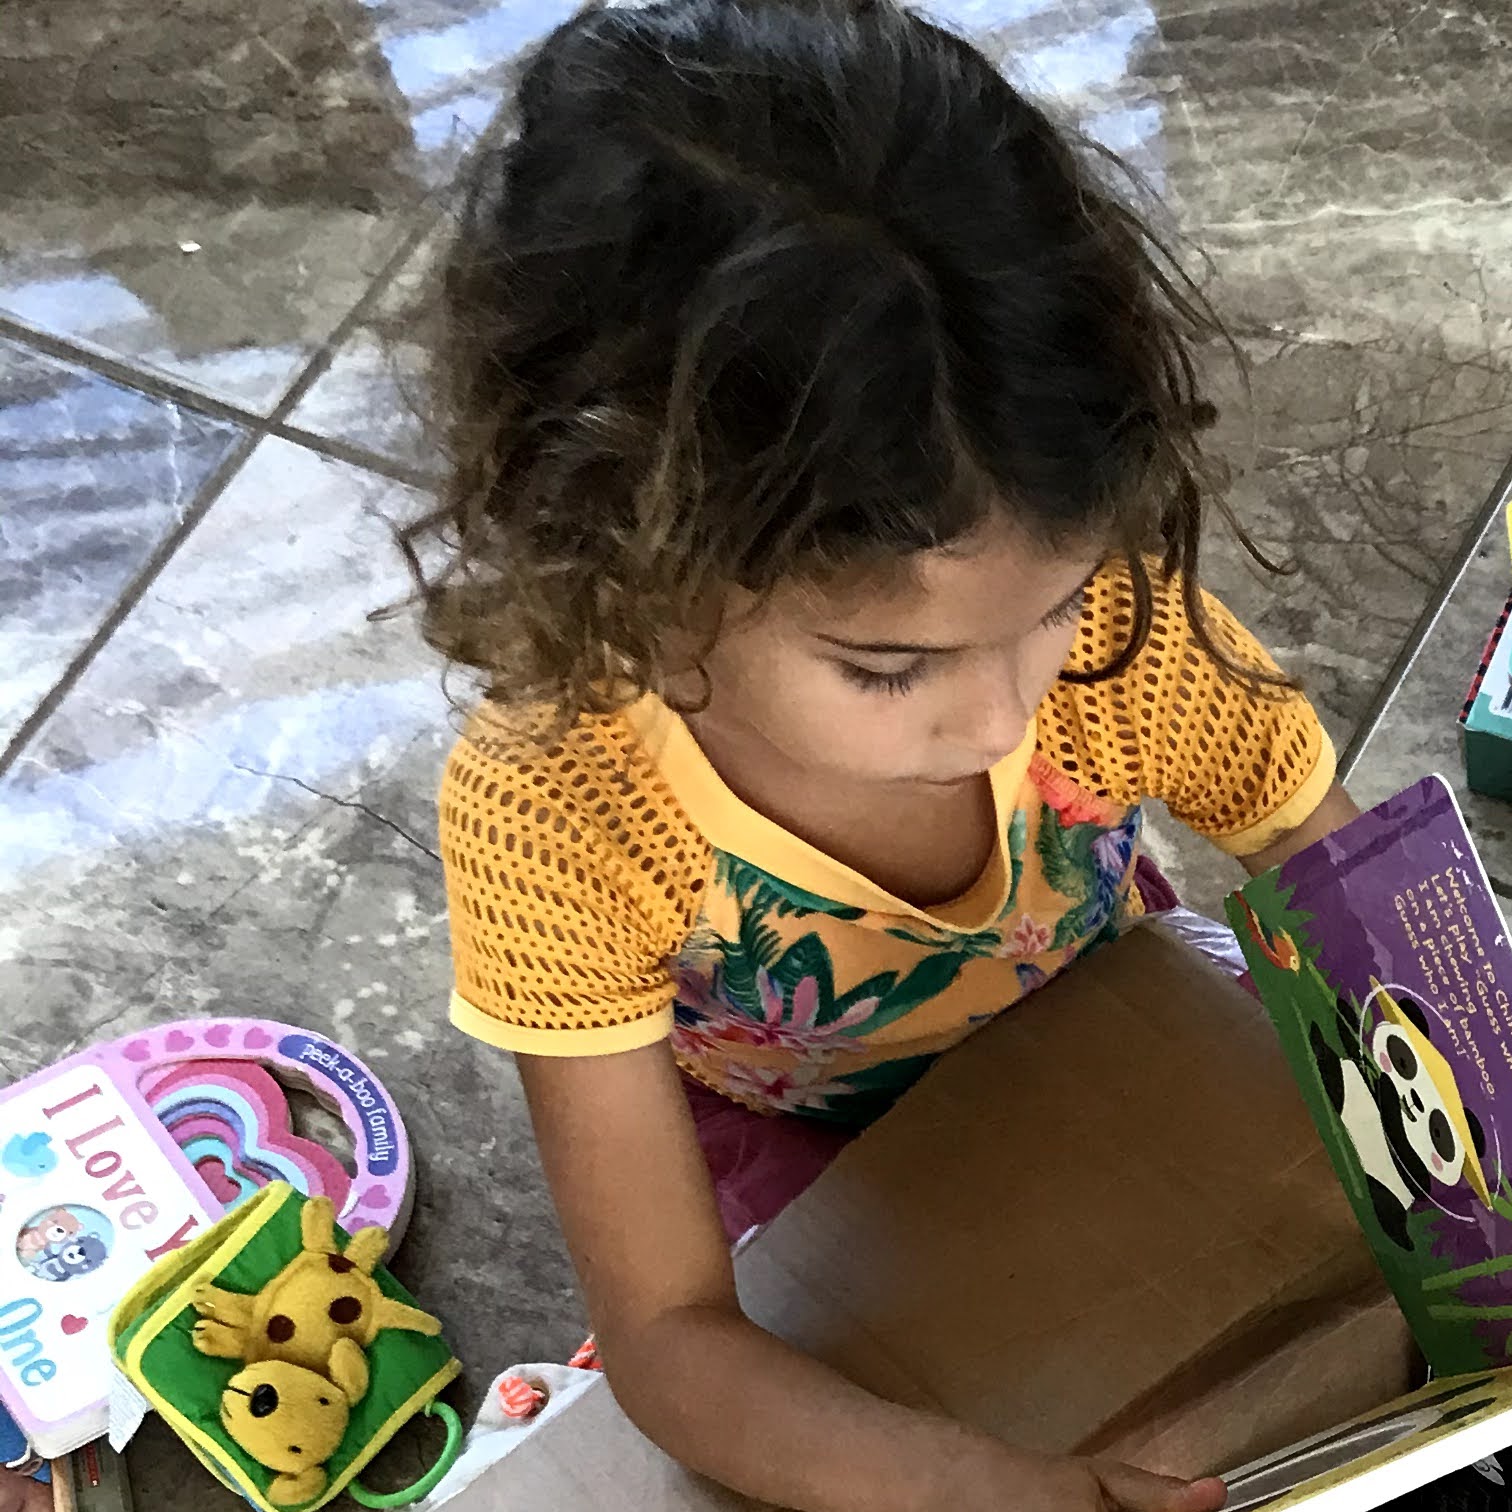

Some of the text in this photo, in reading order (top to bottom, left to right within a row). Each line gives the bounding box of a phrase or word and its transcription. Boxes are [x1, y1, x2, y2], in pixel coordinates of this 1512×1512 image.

[1406, 888, 1419, 916] on
[1418, 880, 1477, 1014] I am chewing
[1419, 922, 1428, 932] a
[1431, 874, 1453, 918] Let's
[1448, 924, 1473, 964] play
[1446, 867, 1485, 957] Welcome
[1483, 961, 1496, 984] to
[1394, 894, 1450, 1013] Guess who I
[1422, 937, 1450, 985] piece
[1449, 992, 1465, 1012] of
[299, 1044, 395, 1161] peek-a-boo family
[42, 1083, 159, 1230] I Love
[0, 1297, 57, 1387] One
